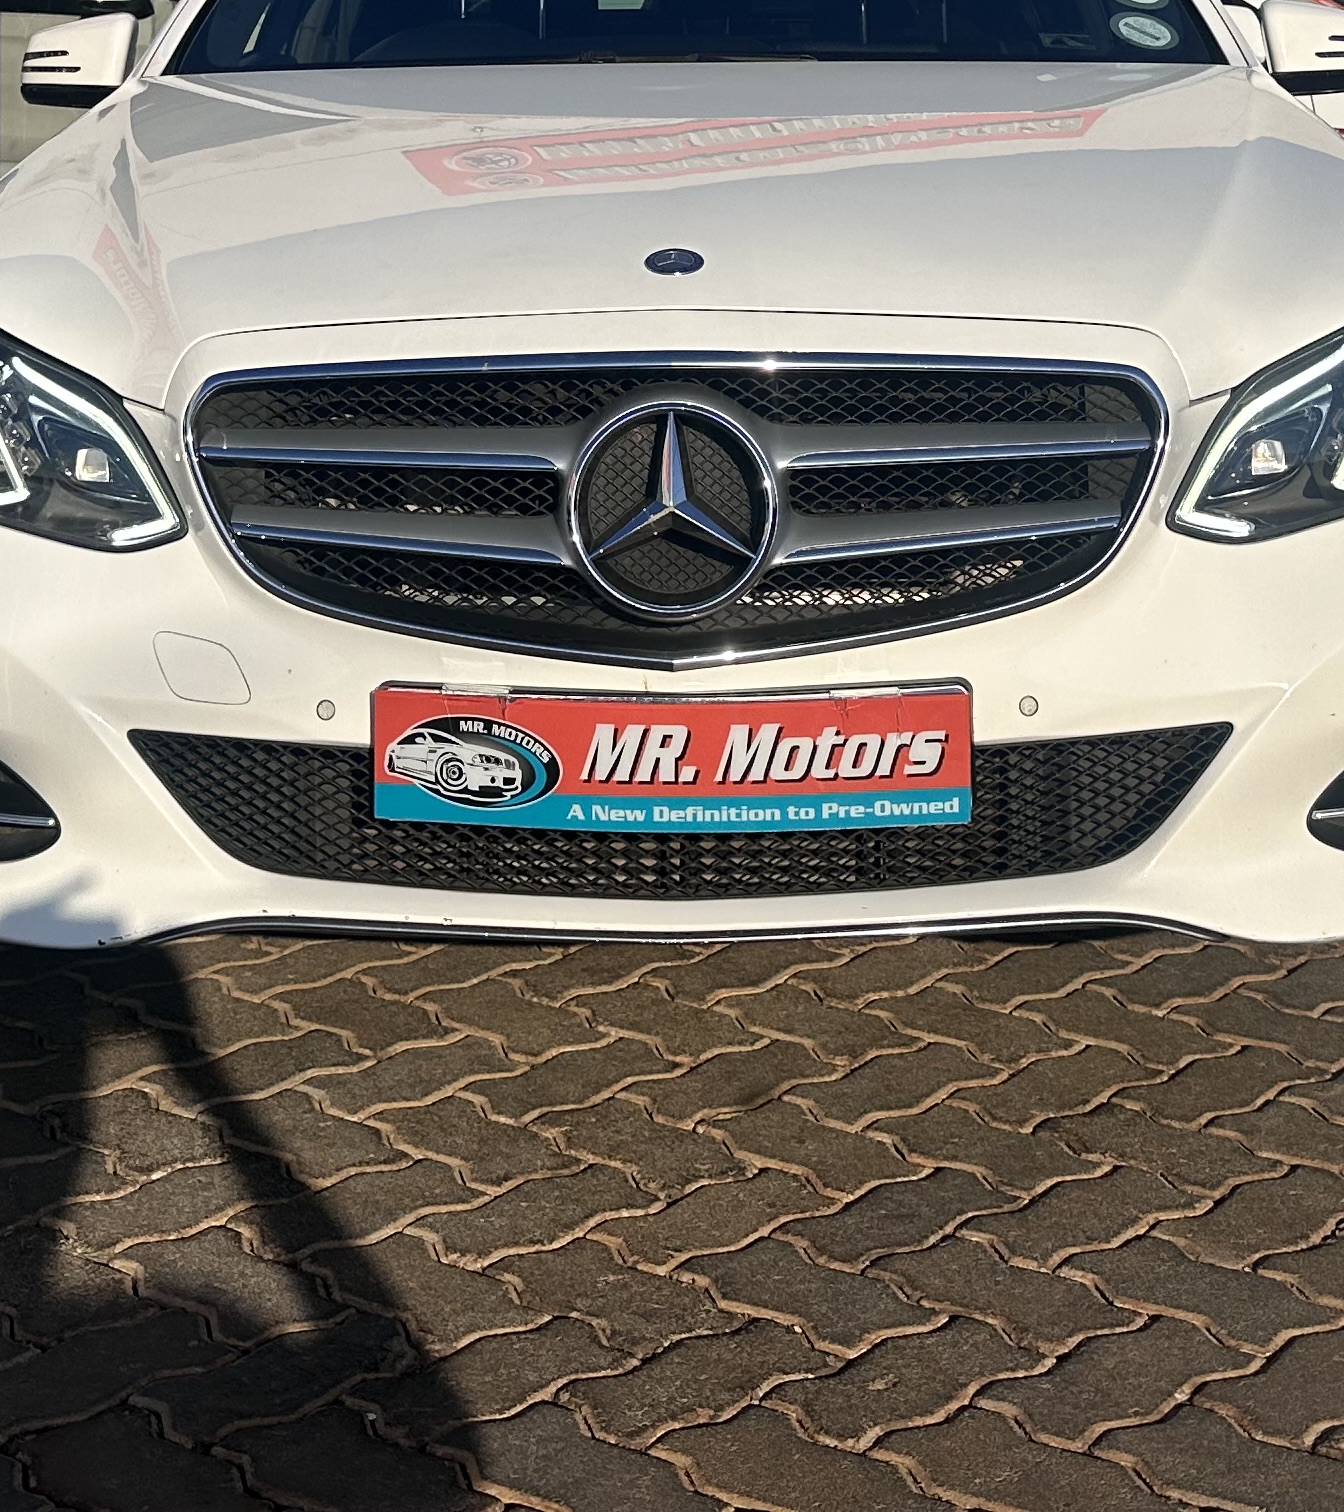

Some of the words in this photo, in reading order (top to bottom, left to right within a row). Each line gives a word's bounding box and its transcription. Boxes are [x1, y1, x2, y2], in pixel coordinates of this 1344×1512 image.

[459, 719, 489, 735] MR.
[491, 725, 553, 765] MOTORS
[578, 722, 698, 785] MR.
[713, 721, 950, 786] Motors
[566, 803, 586, 821] A
[591, 804, 648, 823] New
[652, 805, 783, 824] Definition
[786, 804, 815, 821] to
[821, 796, 961, 820] Pre-Owned
